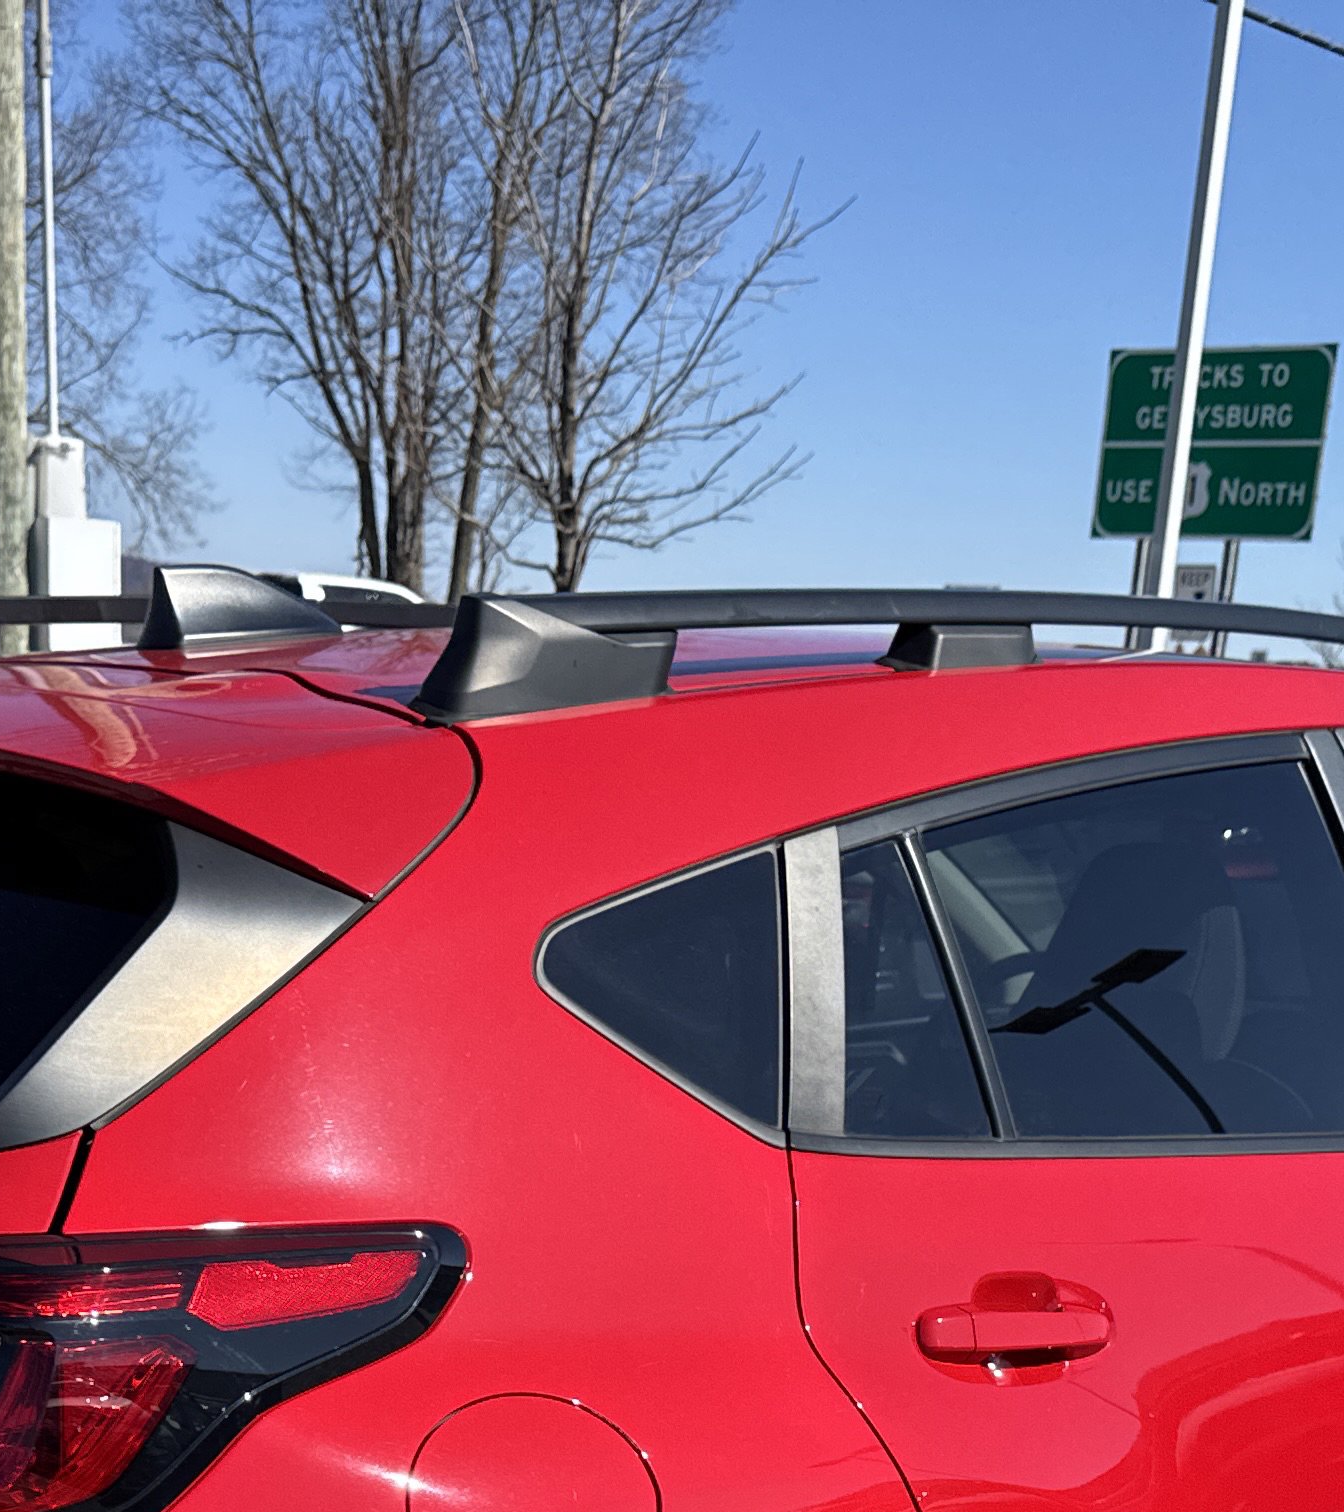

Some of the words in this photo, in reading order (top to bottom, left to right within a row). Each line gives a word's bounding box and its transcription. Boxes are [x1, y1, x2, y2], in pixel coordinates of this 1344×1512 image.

[1149, 363, 1245, 390] TRCKS
[1258, 362, 1291, 388] TO
[1135, 403, 1294, 430] GEYSBURG
[1105, 478, 1154, 503] USE
[1218, 476, 1307, 507] NORTH
